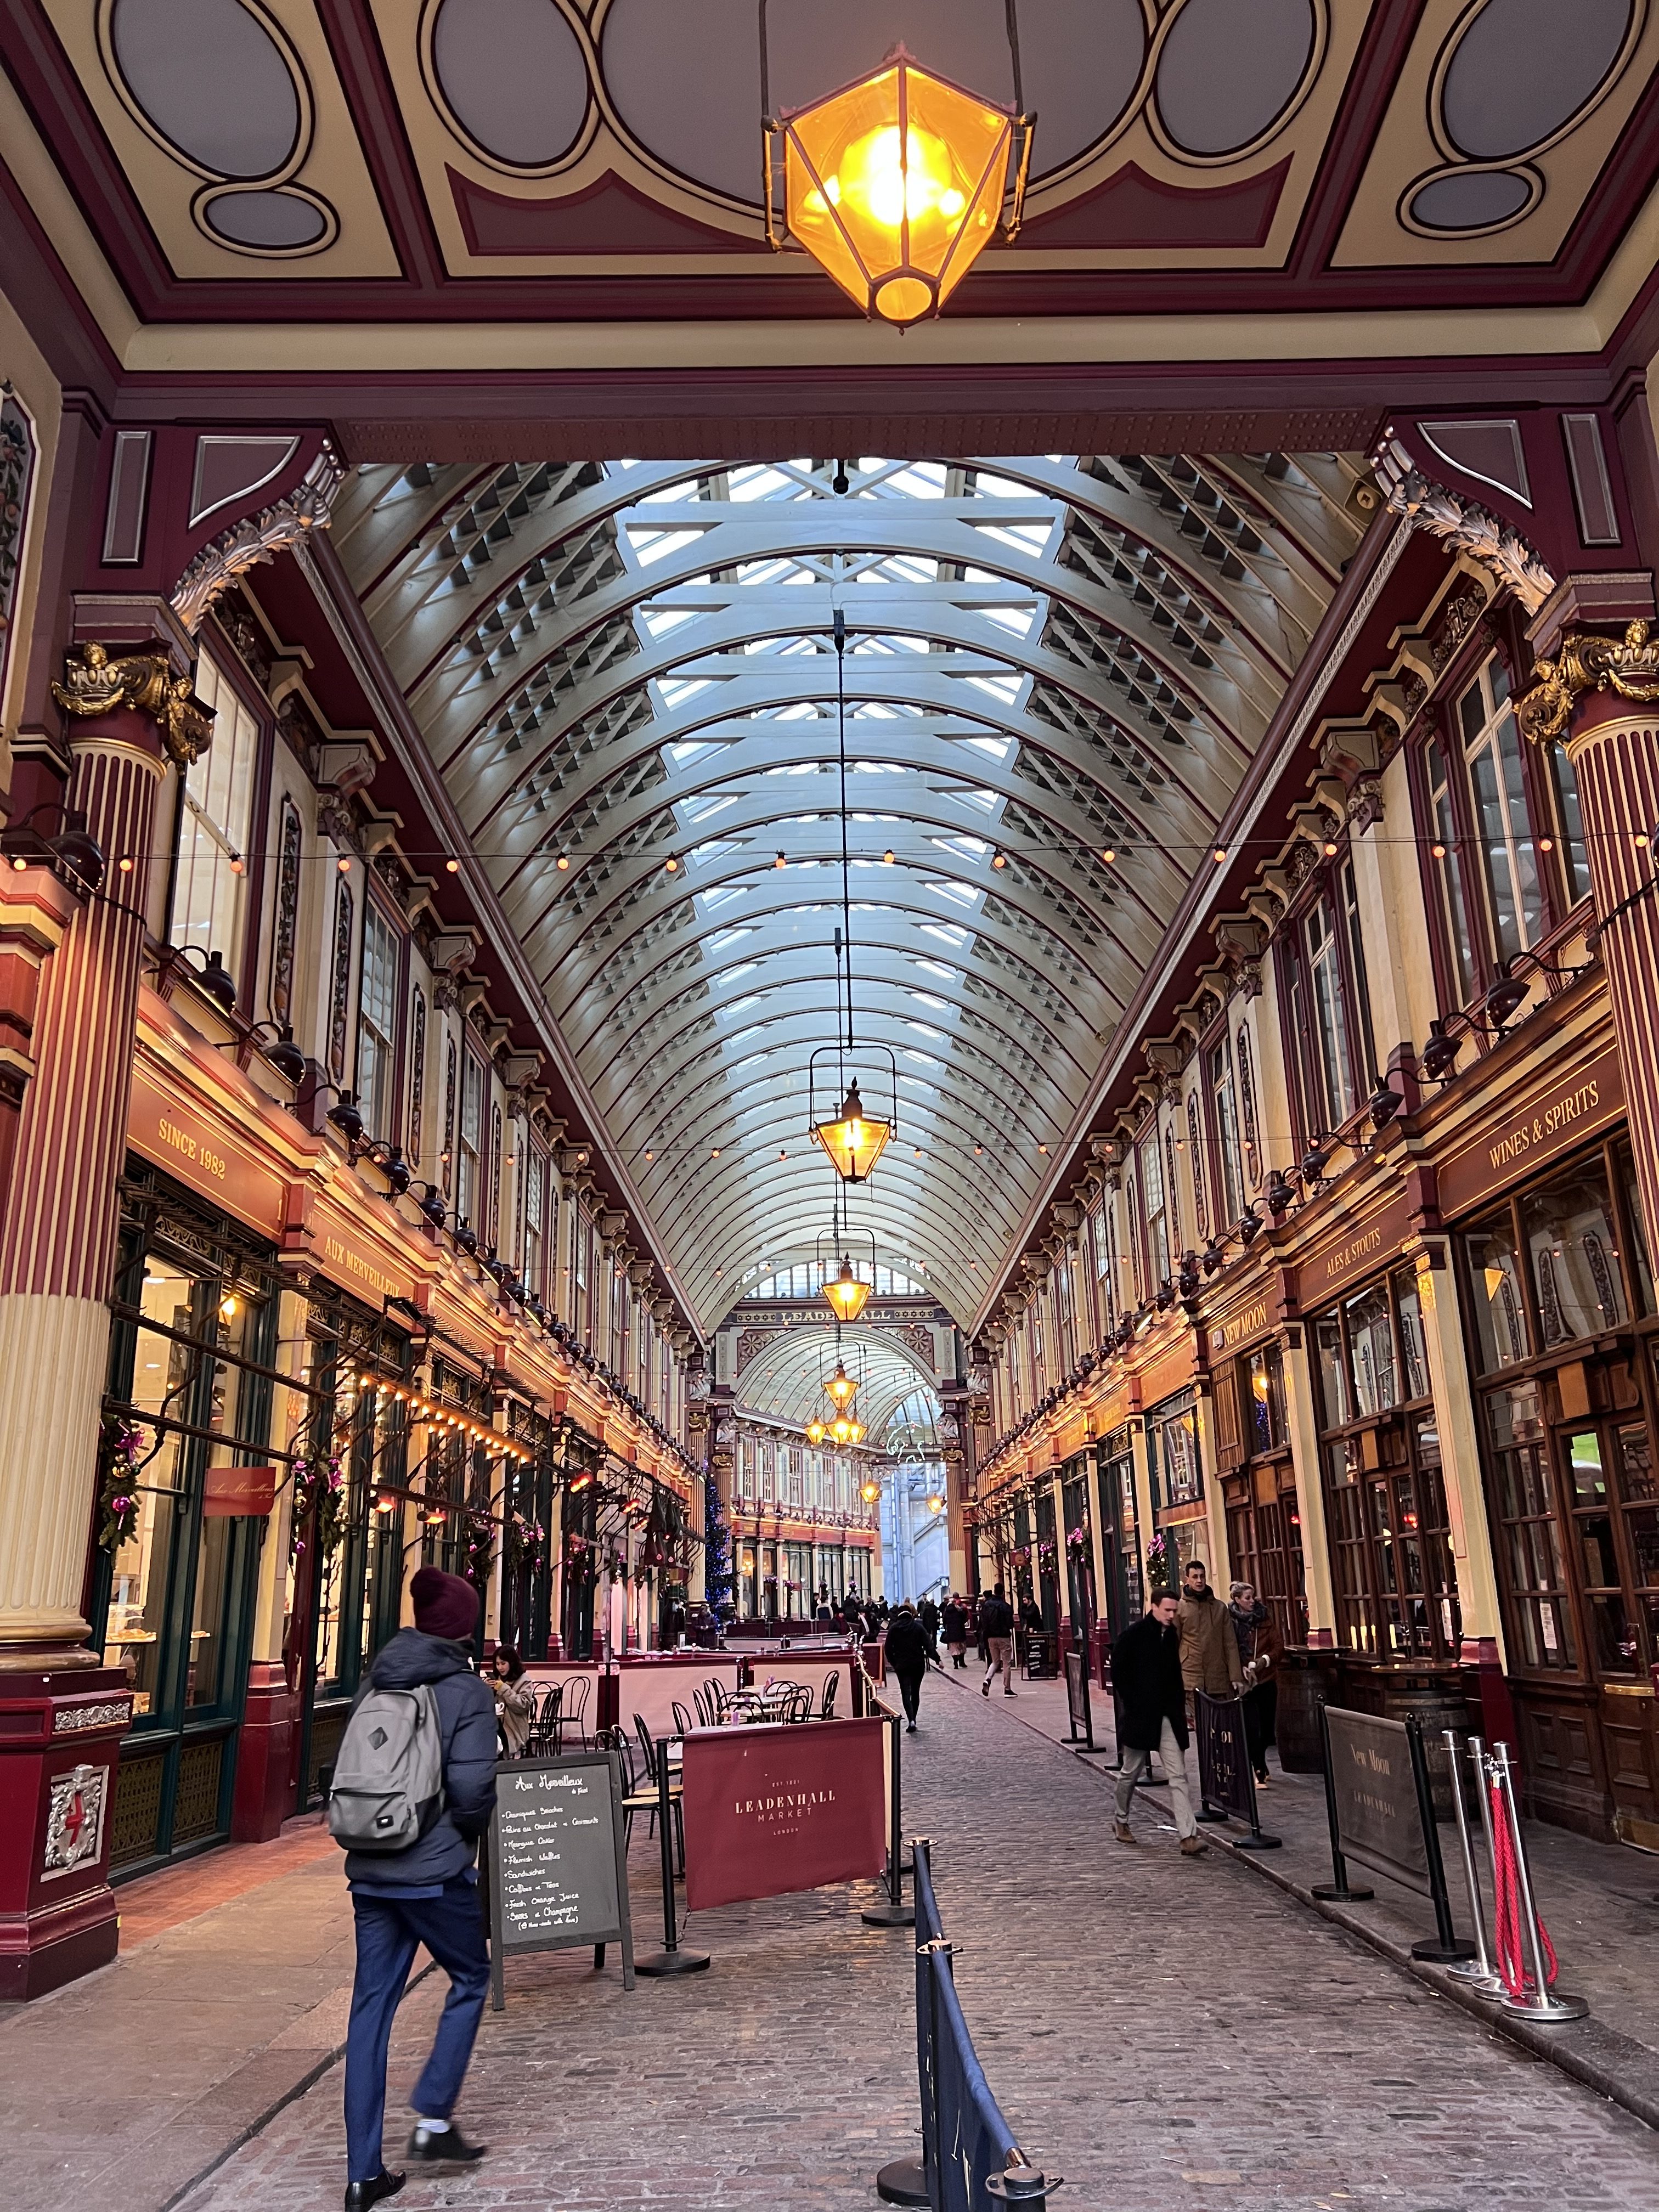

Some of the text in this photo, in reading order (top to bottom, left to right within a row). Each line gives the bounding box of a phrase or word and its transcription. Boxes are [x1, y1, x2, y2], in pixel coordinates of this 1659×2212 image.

[1489, 1080, 1599, 1169] WINES & SPIRITS
[158, 1118, 225, 1180] SINCE 1982
[1327, 1227, 1380, 1278] ALES & STOUTS
[325, 1236, 400, 1297] AUX MERVEILLEUX
[781, 1310, 891, 1322] LEADEALL
[1223, 1301, 1267, 1347] NEW MOON
[1369, 1749, 1390, 1775] Moon
[515, 1776, 533, 1791] Aux
[736, 1790, 835, 1814] LEADENHALL
[758, 1808, 811, 1822] MARKET
[508, 1852, 561, 1865] Flemish Waffles
[507, 1868, 545, 1879] Sandwiches
[509, 1883, 532, 1893] Coffees
[531, 1896, 556, 1905] Orange
[559, 1893, 579, 1902] Juice
[544, 1905, 579, 1917] Champagne
